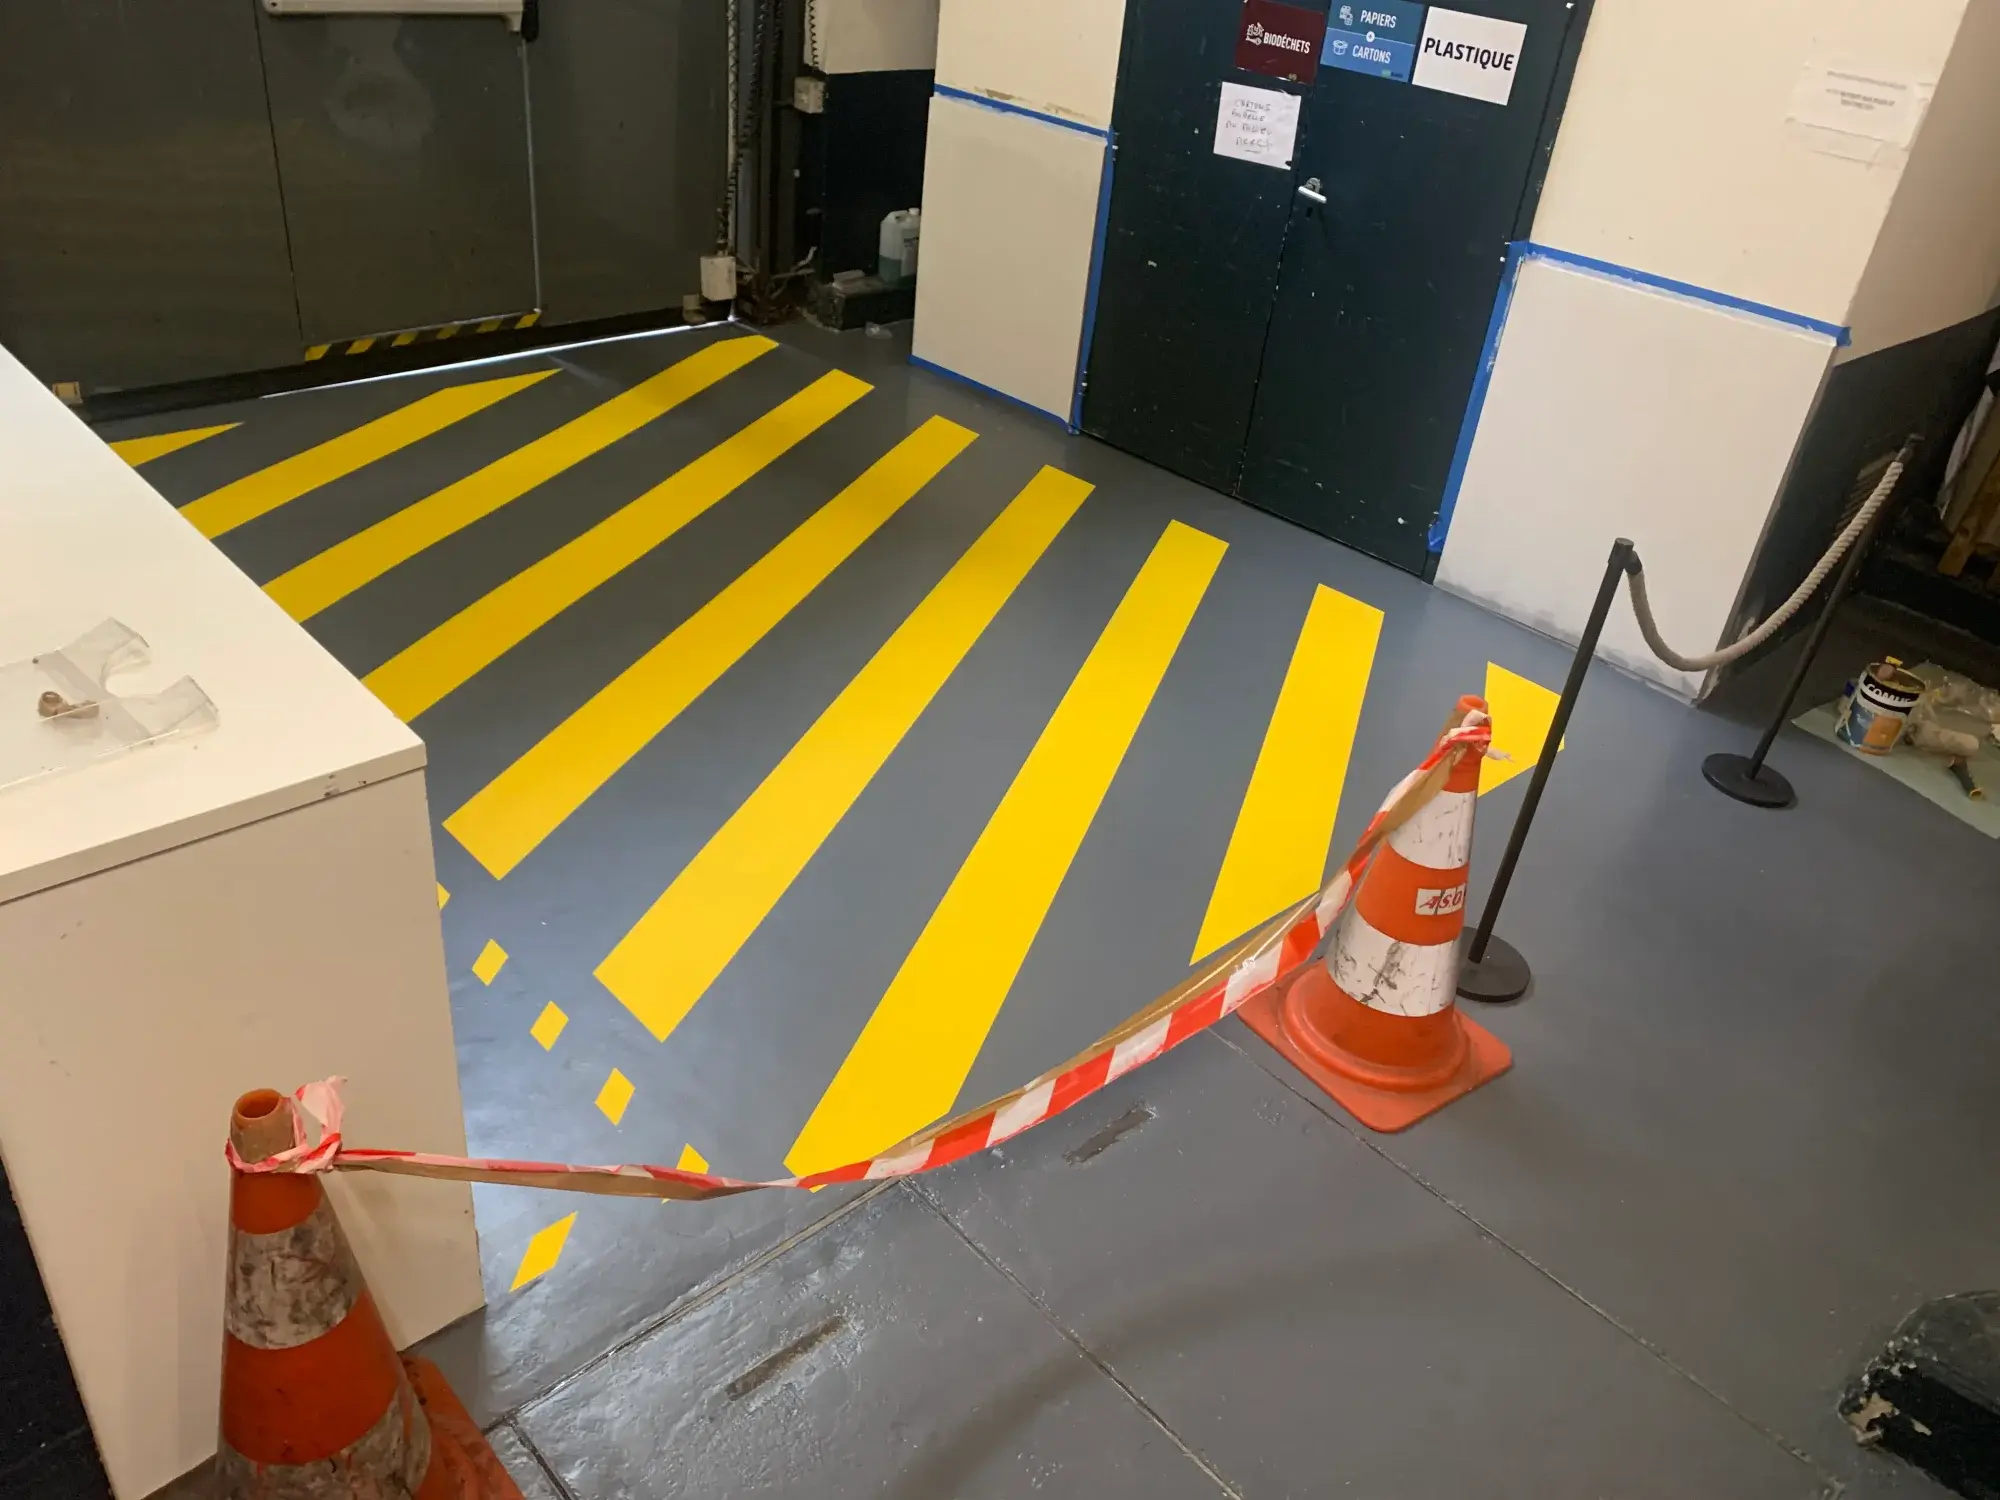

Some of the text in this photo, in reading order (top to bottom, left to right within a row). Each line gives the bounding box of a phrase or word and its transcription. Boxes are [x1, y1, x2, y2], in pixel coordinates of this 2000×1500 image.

[1360, 10, 1396, 29] PAPIERS
[1263, 32, 1311, 54] BIODÉCHETS
[1352, 44, 1391, 64] CARTONS
[1424, 37, 1515, 72] PLASTIQUE
